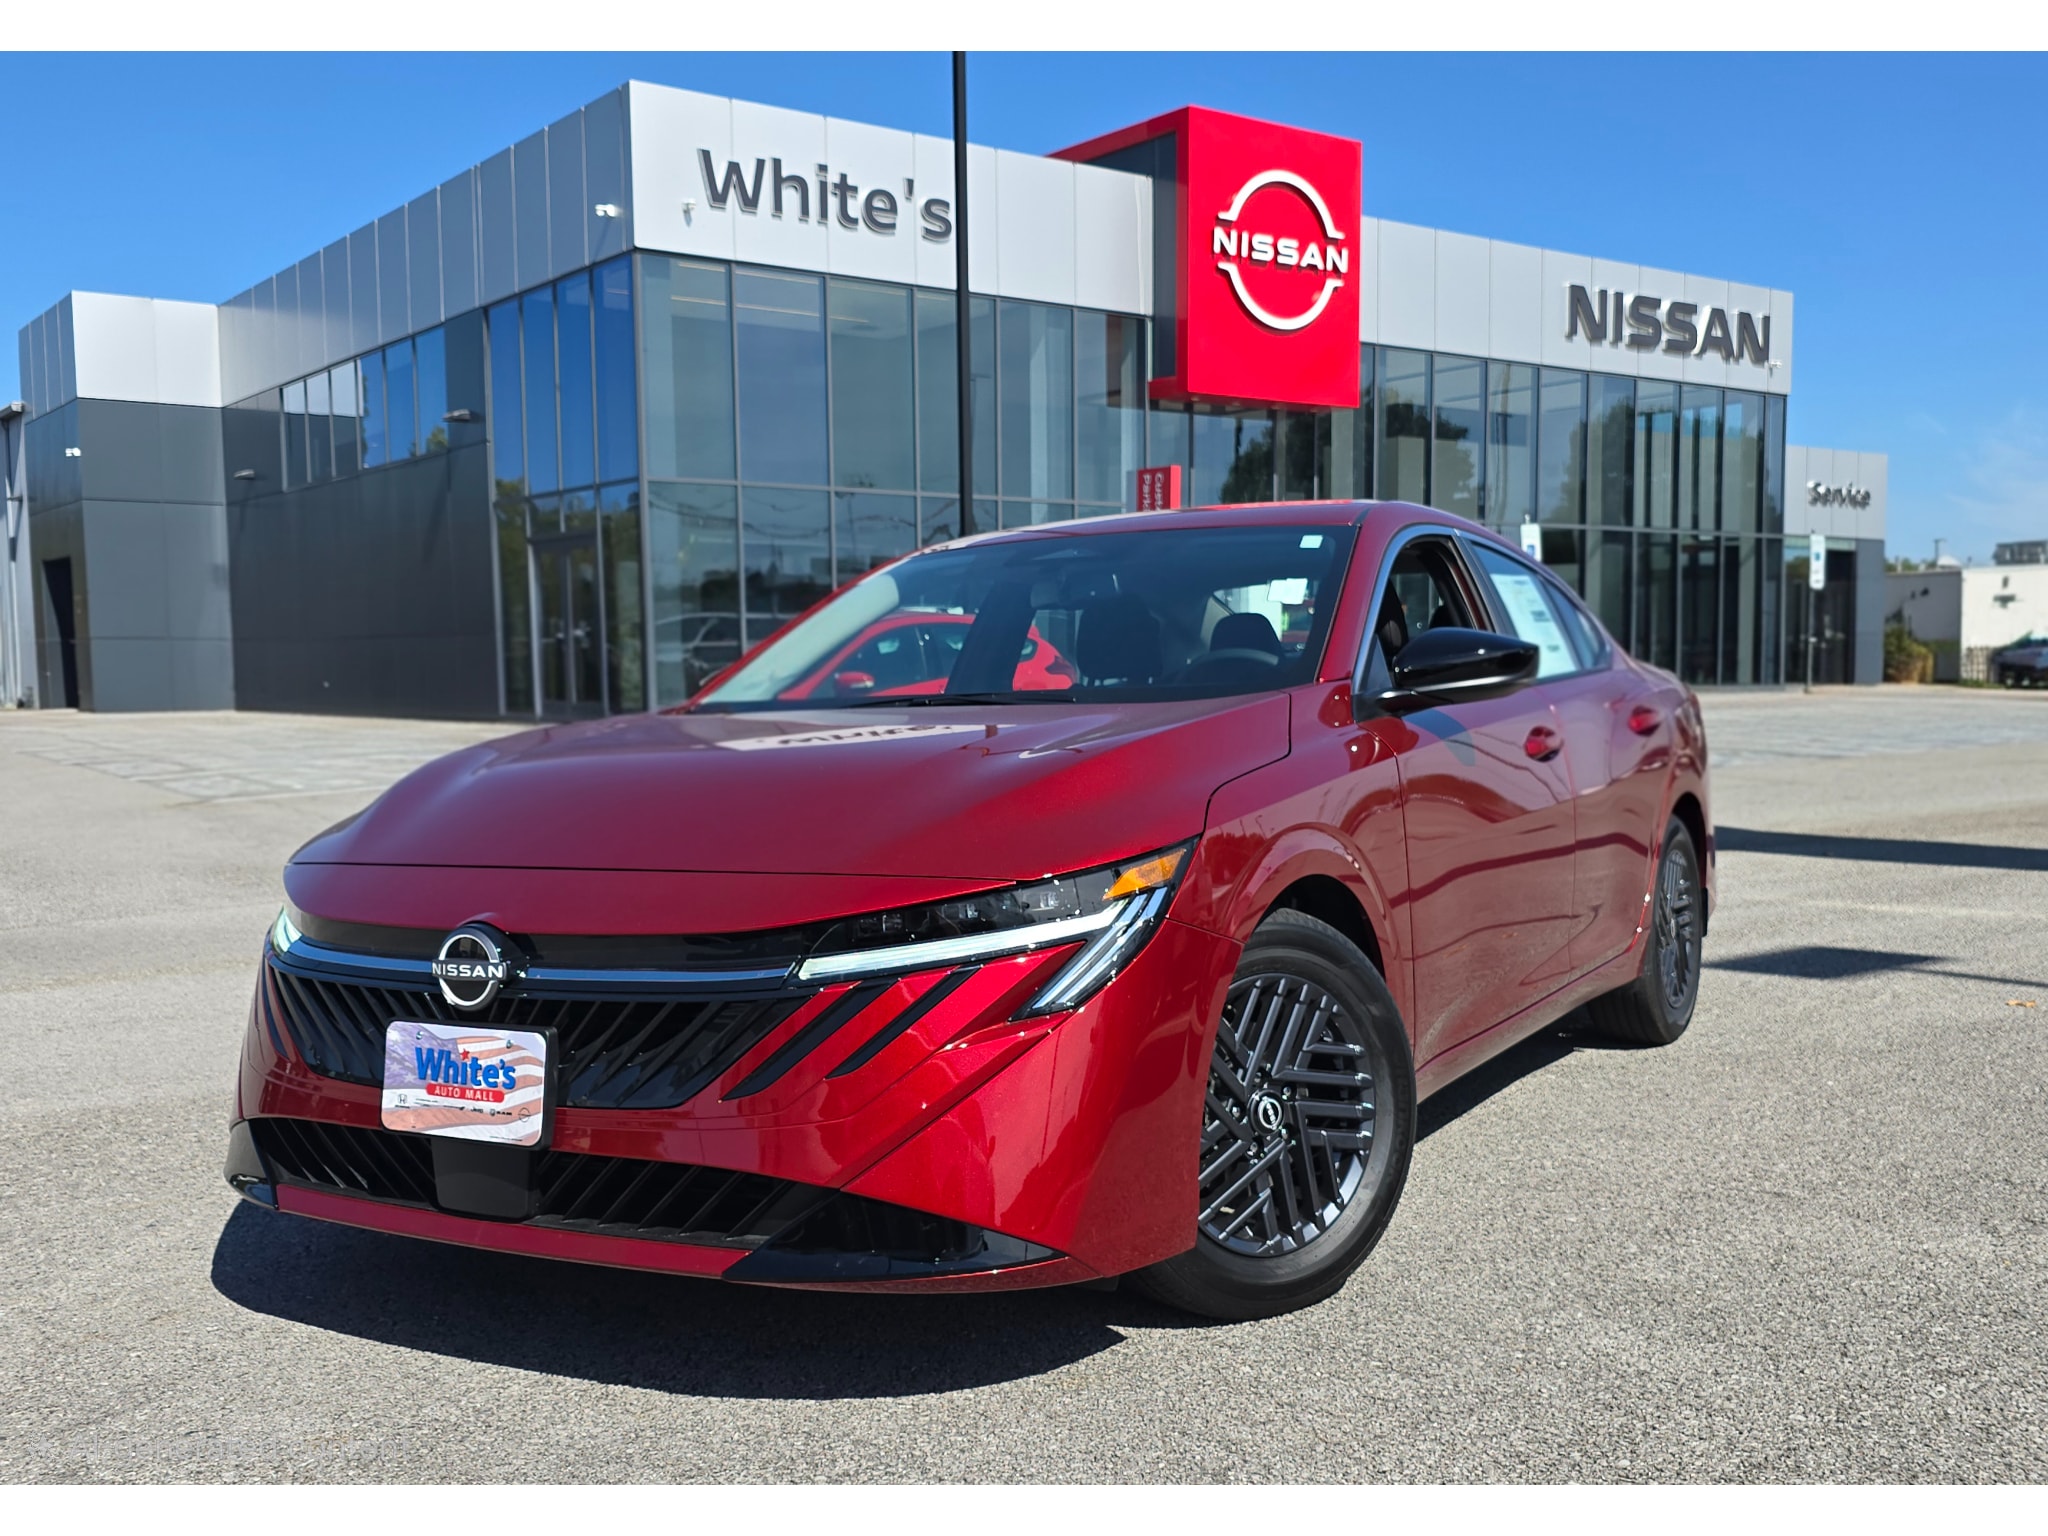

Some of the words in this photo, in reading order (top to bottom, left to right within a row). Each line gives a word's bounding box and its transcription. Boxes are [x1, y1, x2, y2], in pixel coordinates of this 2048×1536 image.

[696, 147, 952, 243] White's
[1213, 226, 1349, 274] NISSAN
[1564, 283, 1771, 364] NISSAN
[1807, 481, 1871, 510] Service
[432, 961, 503, 978] NISSAN
[415, 1046, 516, 1090] White's
[434, 1085, 460, 1098] AUTO
[465, 1089, 494, 1101] MALL
